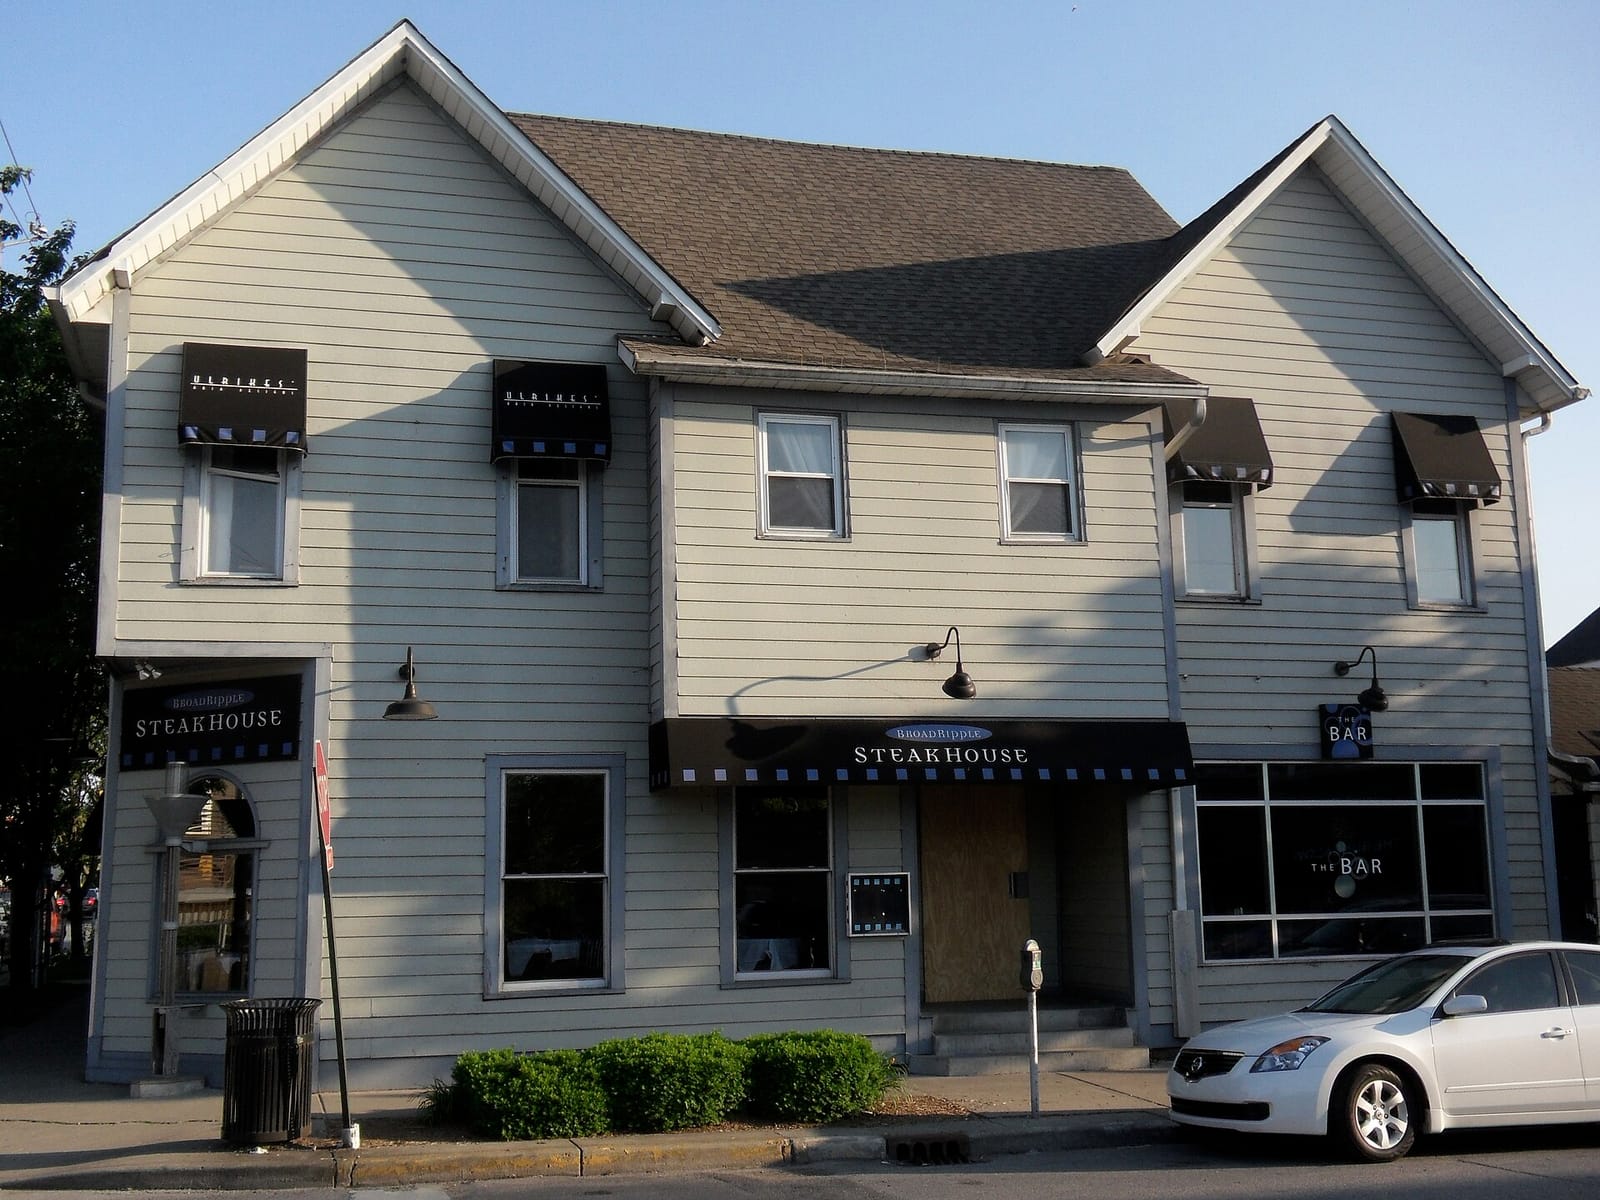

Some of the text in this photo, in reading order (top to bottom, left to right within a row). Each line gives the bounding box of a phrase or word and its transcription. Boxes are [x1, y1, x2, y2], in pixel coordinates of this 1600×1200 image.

[135, 709, 282, 738] STEAKHOUSE
[1329, 726, 1367, 742] BAR
[854, 746, 1028, 764] STEAKHOUSE
[1311, 857, 1383, 875] THE BAR
